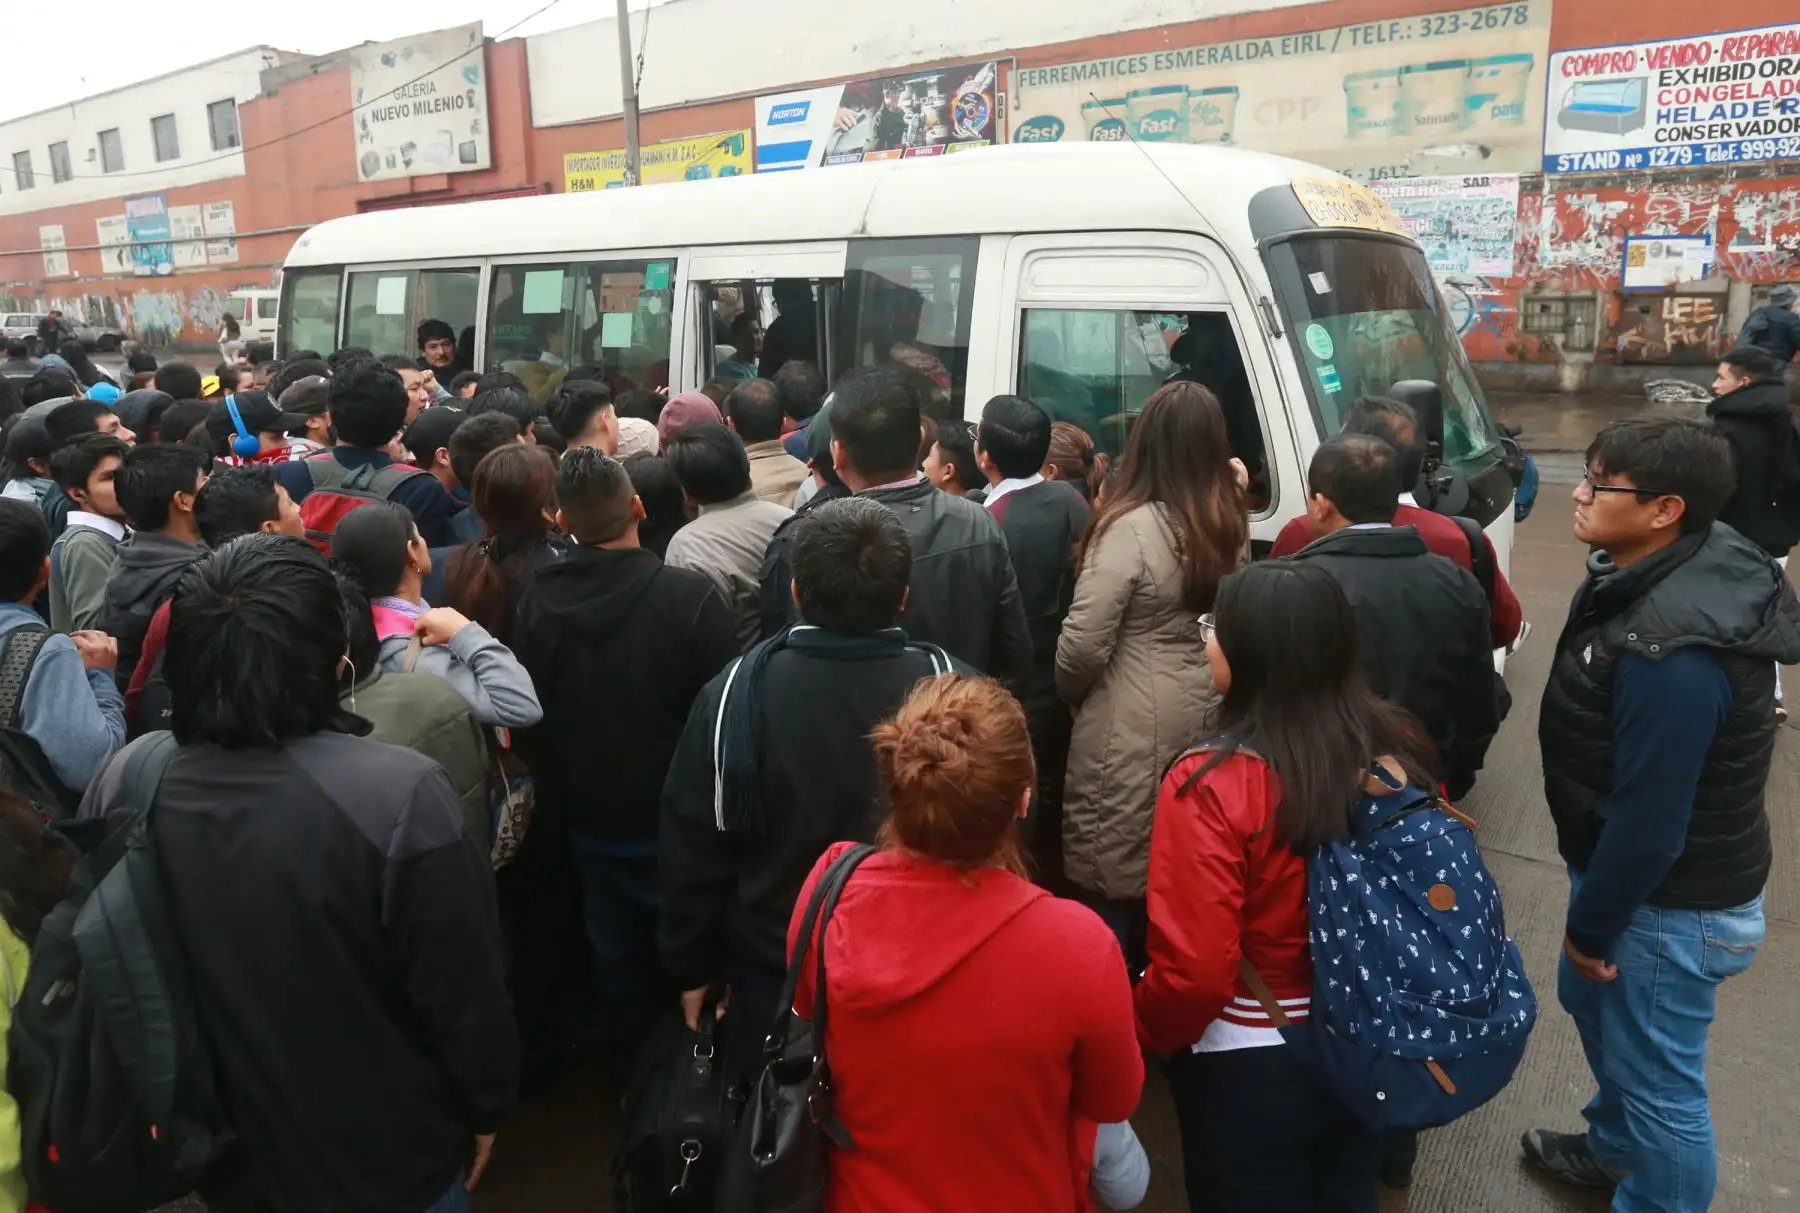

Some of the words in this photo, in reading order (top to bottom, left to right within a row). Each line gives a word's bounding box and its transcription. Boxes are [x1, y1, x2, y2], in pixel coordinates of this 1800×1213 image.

[1019, 56, 1148, 87] FERREMATICES
[1154, 40, 1274, 71] ESMERALDA
[1281, 35, 1326, 56] EIRL
[1349, 22, 1413, 46] TELF.:
[1420, 5, 1529, 38] 323-2678
[1561, 50, 1637, 78] COMPRO
[1645, 41, 1711, 70] VENDO
[1720, 29, 1800, 63] REPARA
[371, 103, 410, 123] NUEVO
[412, 95, 465, 116] MILENIO
[772, 107, 806, 120] NORTON
[1019, 123, 1060, 143] Fast
[1092, 125, 1122, 142] Fast
[1139, 116, 1177, 135] Fast
[1557, 151, 1621, 172] STAND
[1648, 146, 1693, 167] 1279
[571, 178, 594, 190] H&M
[1462, 177, 1490, 188] SAB
